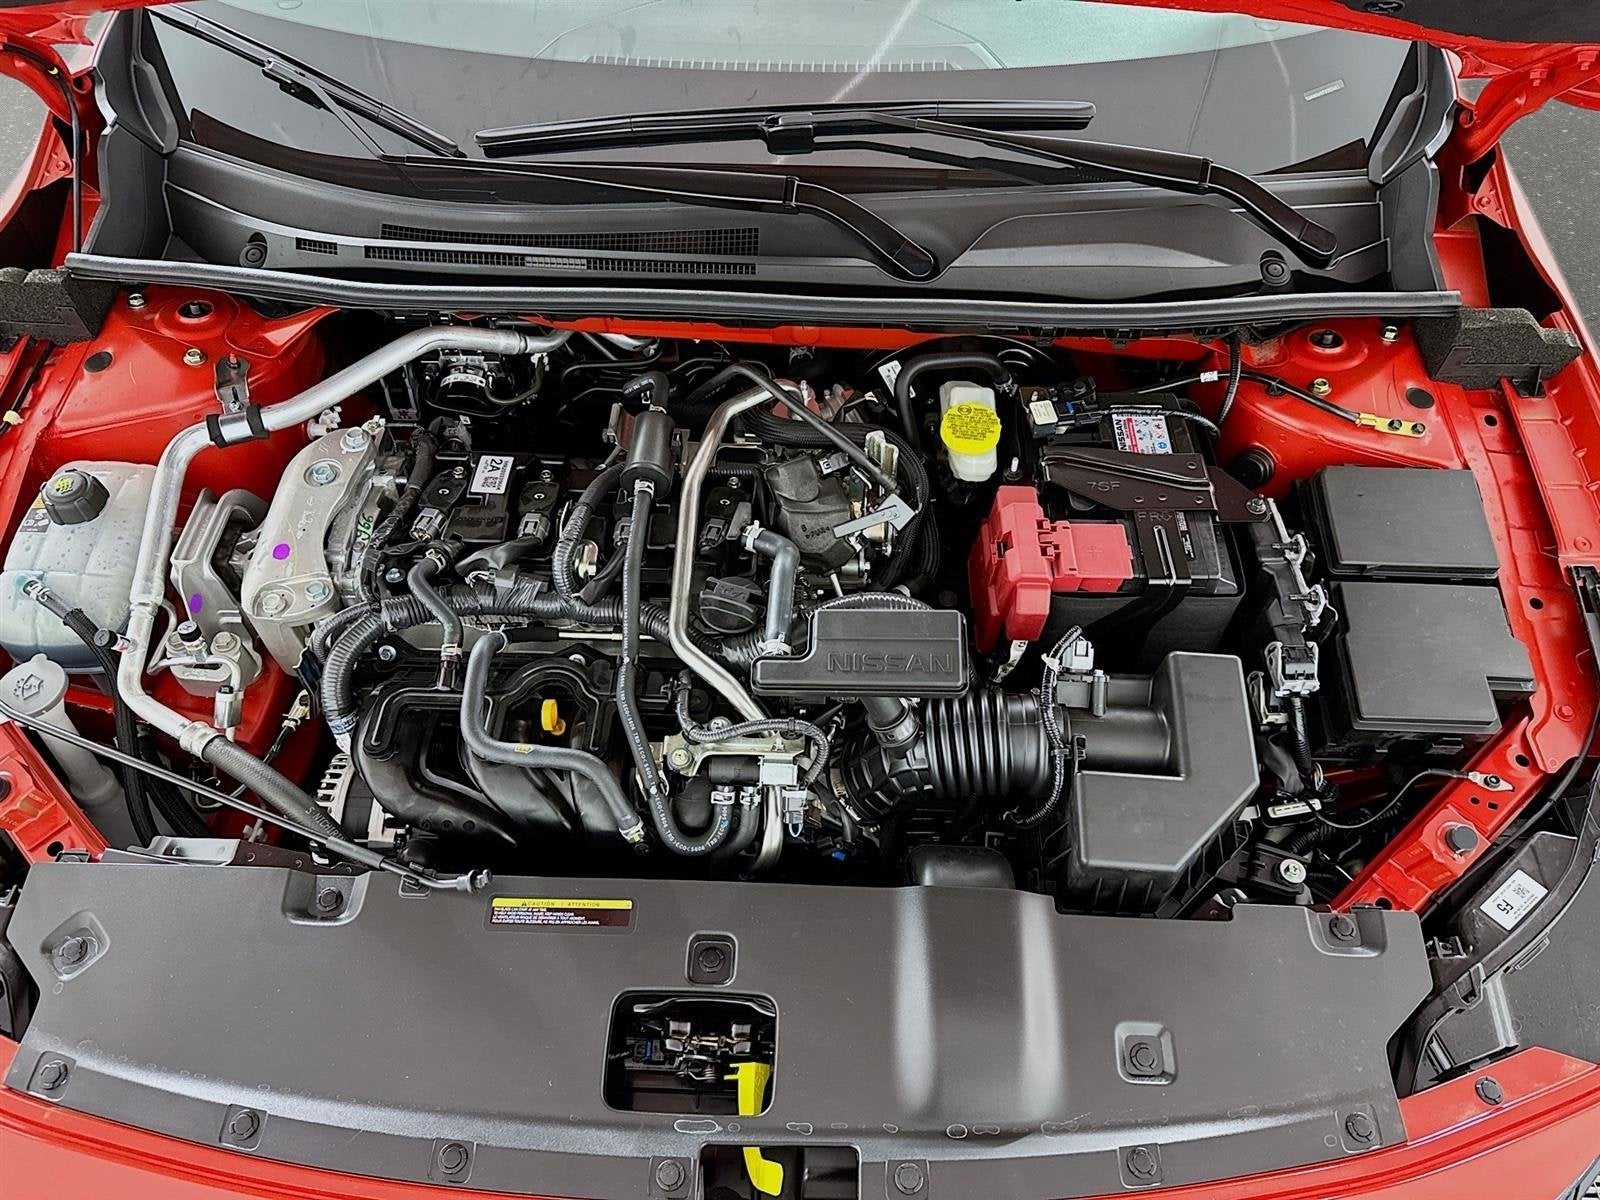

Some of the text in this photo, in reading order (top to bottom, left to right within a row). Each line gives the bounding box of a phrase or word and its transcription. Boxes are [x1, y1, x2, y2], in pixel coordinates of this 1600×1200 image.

[1115, 419, 1127, 450] NISSAN
[487, 458, 503, 473] 2A
[826, 652, 954, 673] NISSAN
[1497, 899, 1514, 915] F5
